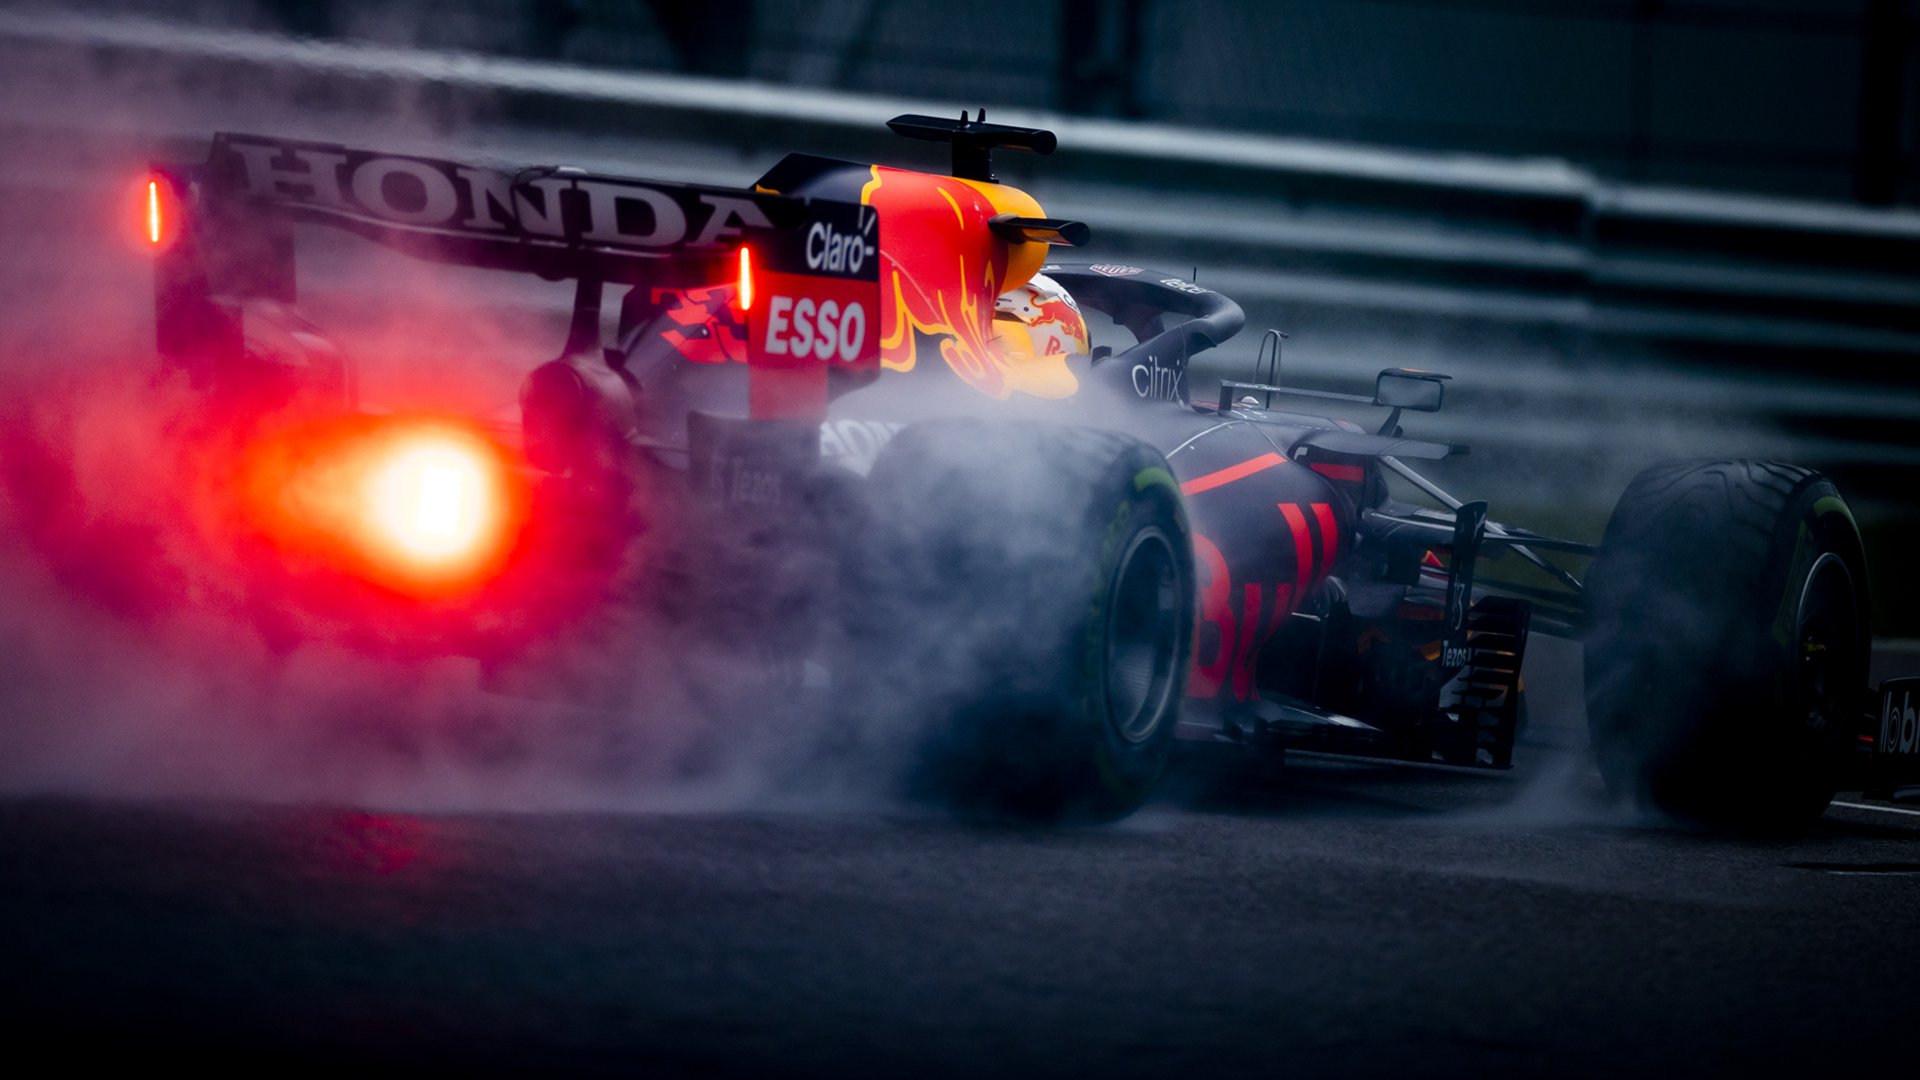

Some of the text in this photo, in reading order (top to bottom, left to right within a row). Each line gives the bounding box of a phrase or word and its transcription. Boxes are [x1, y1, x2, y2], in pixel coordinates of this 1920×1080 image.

[229, 143, 775, 249] HONDA
[805, 221, 866, 274] Claro
[764, 295, 866, 362] ESSO
[1132, 355, 1183, 402] citrix
[1441, 640, 1468, 667] Tezos
